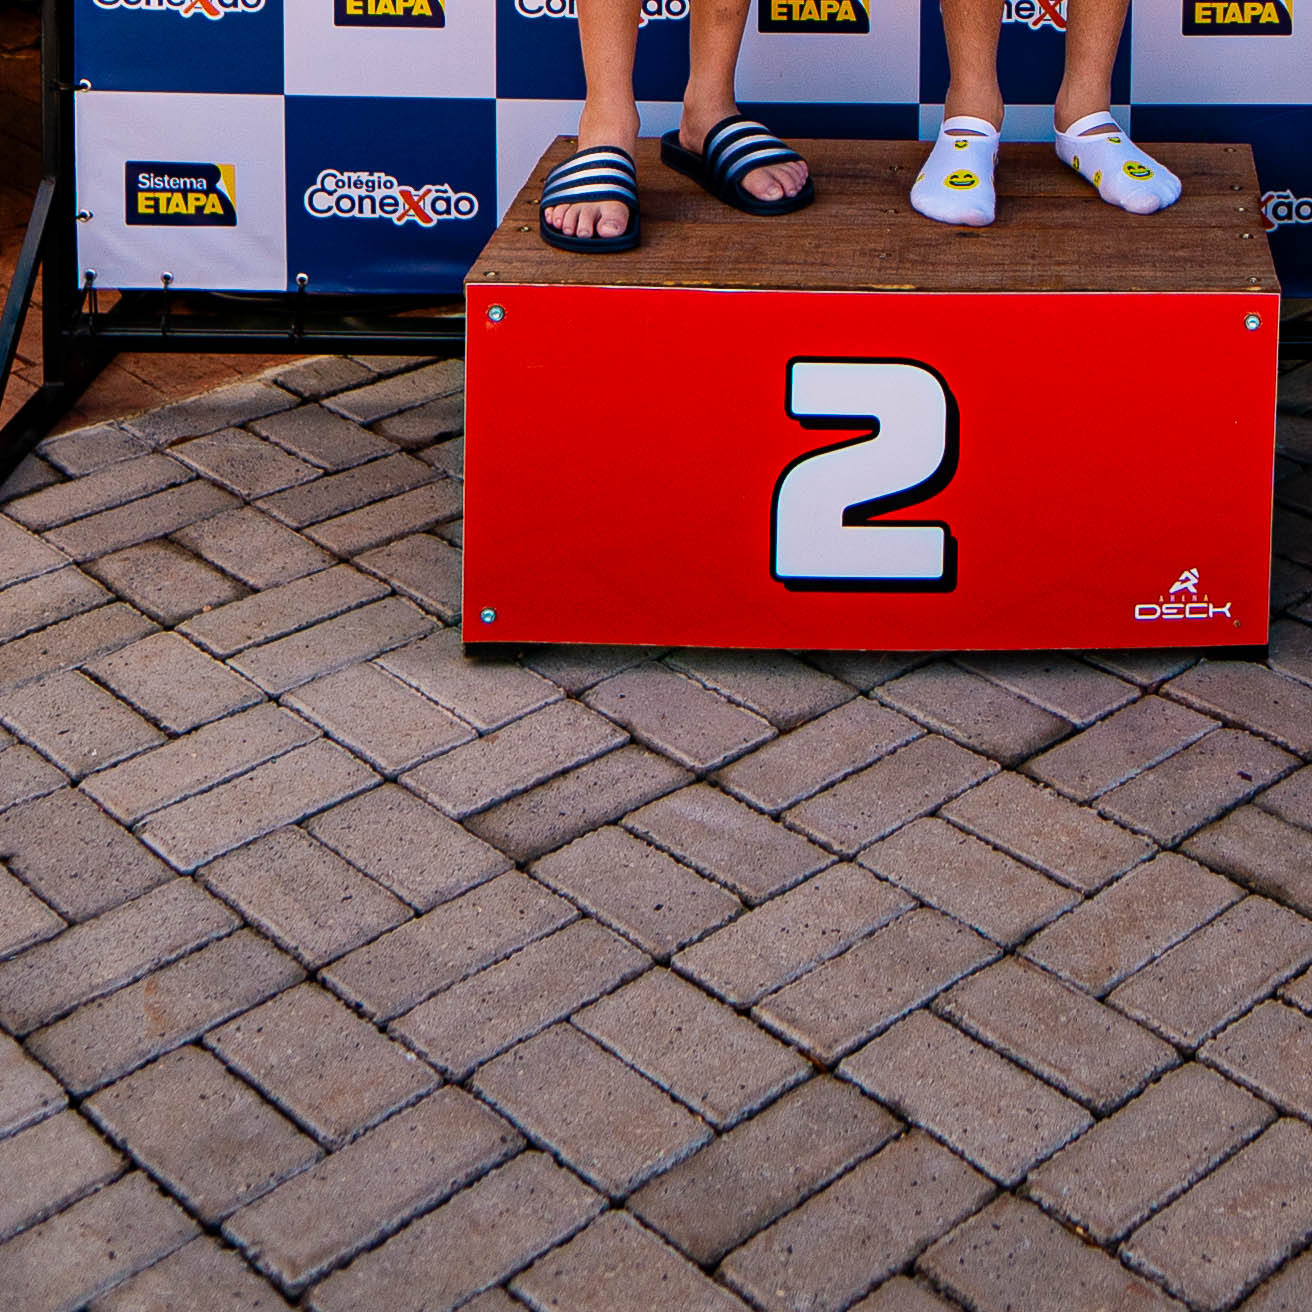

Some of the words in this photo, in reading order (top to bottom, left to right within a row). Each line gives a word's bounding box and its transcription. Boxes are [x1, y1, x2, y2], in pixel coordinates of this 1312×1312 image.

[1193, 0, 1280, 24] ETAPA
[138, 172, 208, 191] Sistema
[319, 172, 394, 195] Colégio
[137, 190, 224, 215] ETAPA
[771, 357, 957, 590] 2
[1134, 601, 1232, 620] DECK
